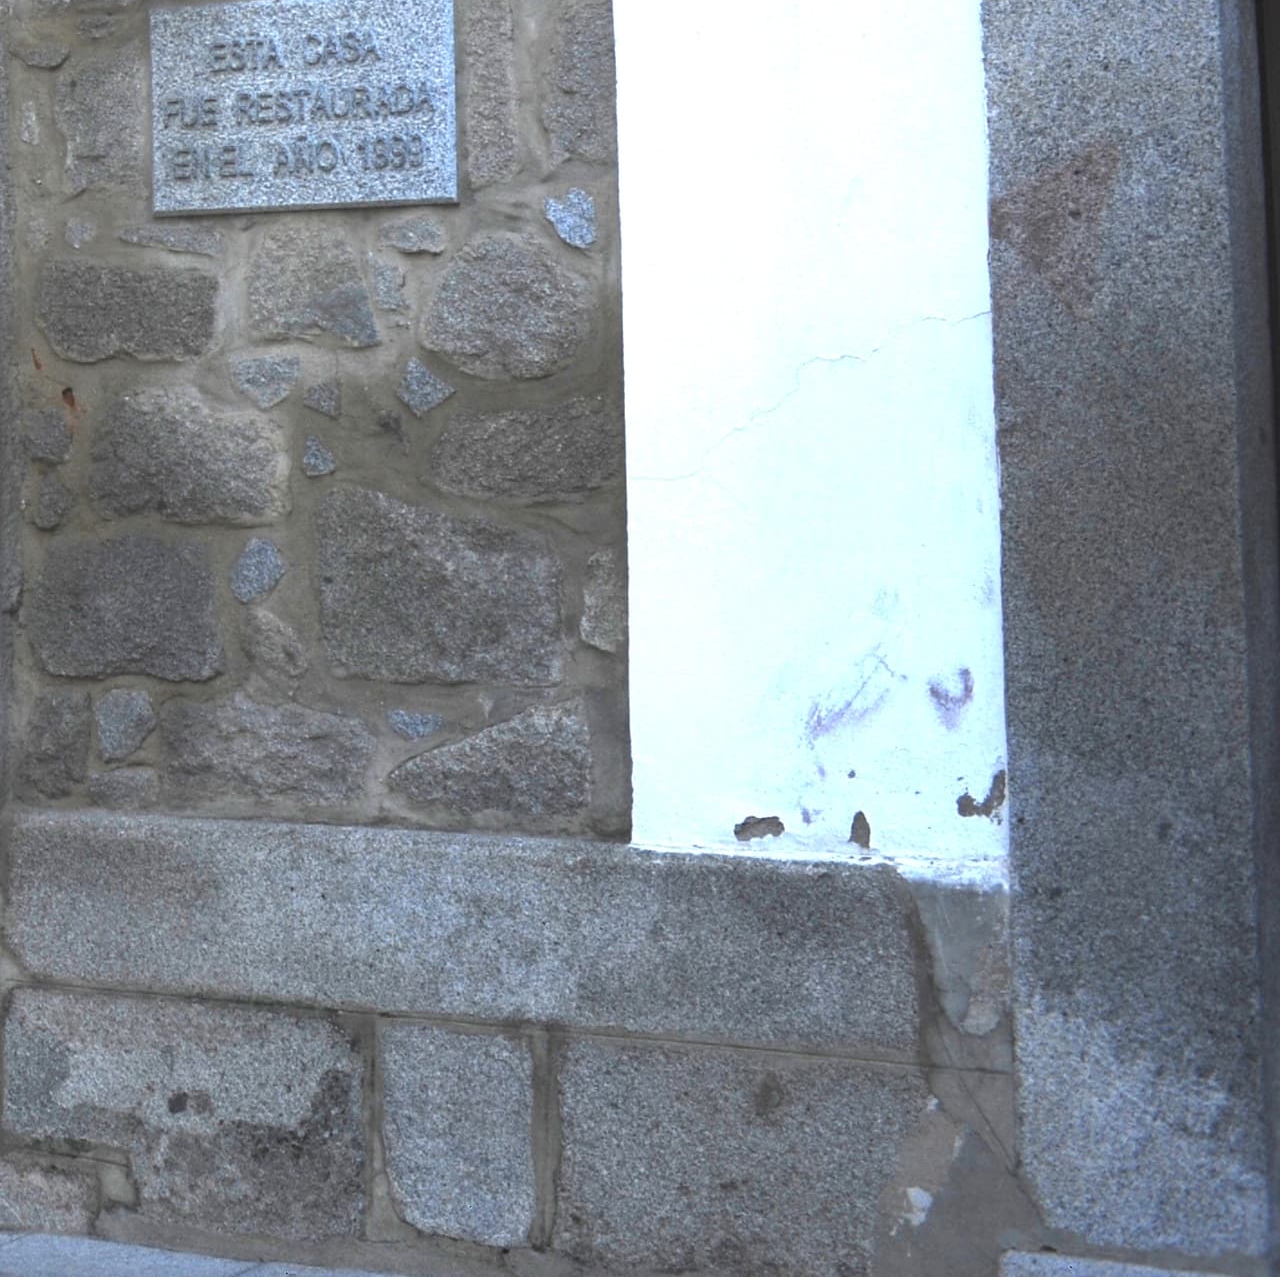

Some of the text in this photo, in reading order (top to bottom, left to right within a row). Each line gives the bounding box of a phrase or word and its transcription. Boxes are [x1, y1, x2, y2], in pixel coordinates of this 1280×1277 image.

[209, 30, 382, 73] ESTA CASA
[162, 82, 437, 130] FUE RESTAURADA
[220, 144, 255, 178] EL
[272, 135, 339, 177] AÑO
